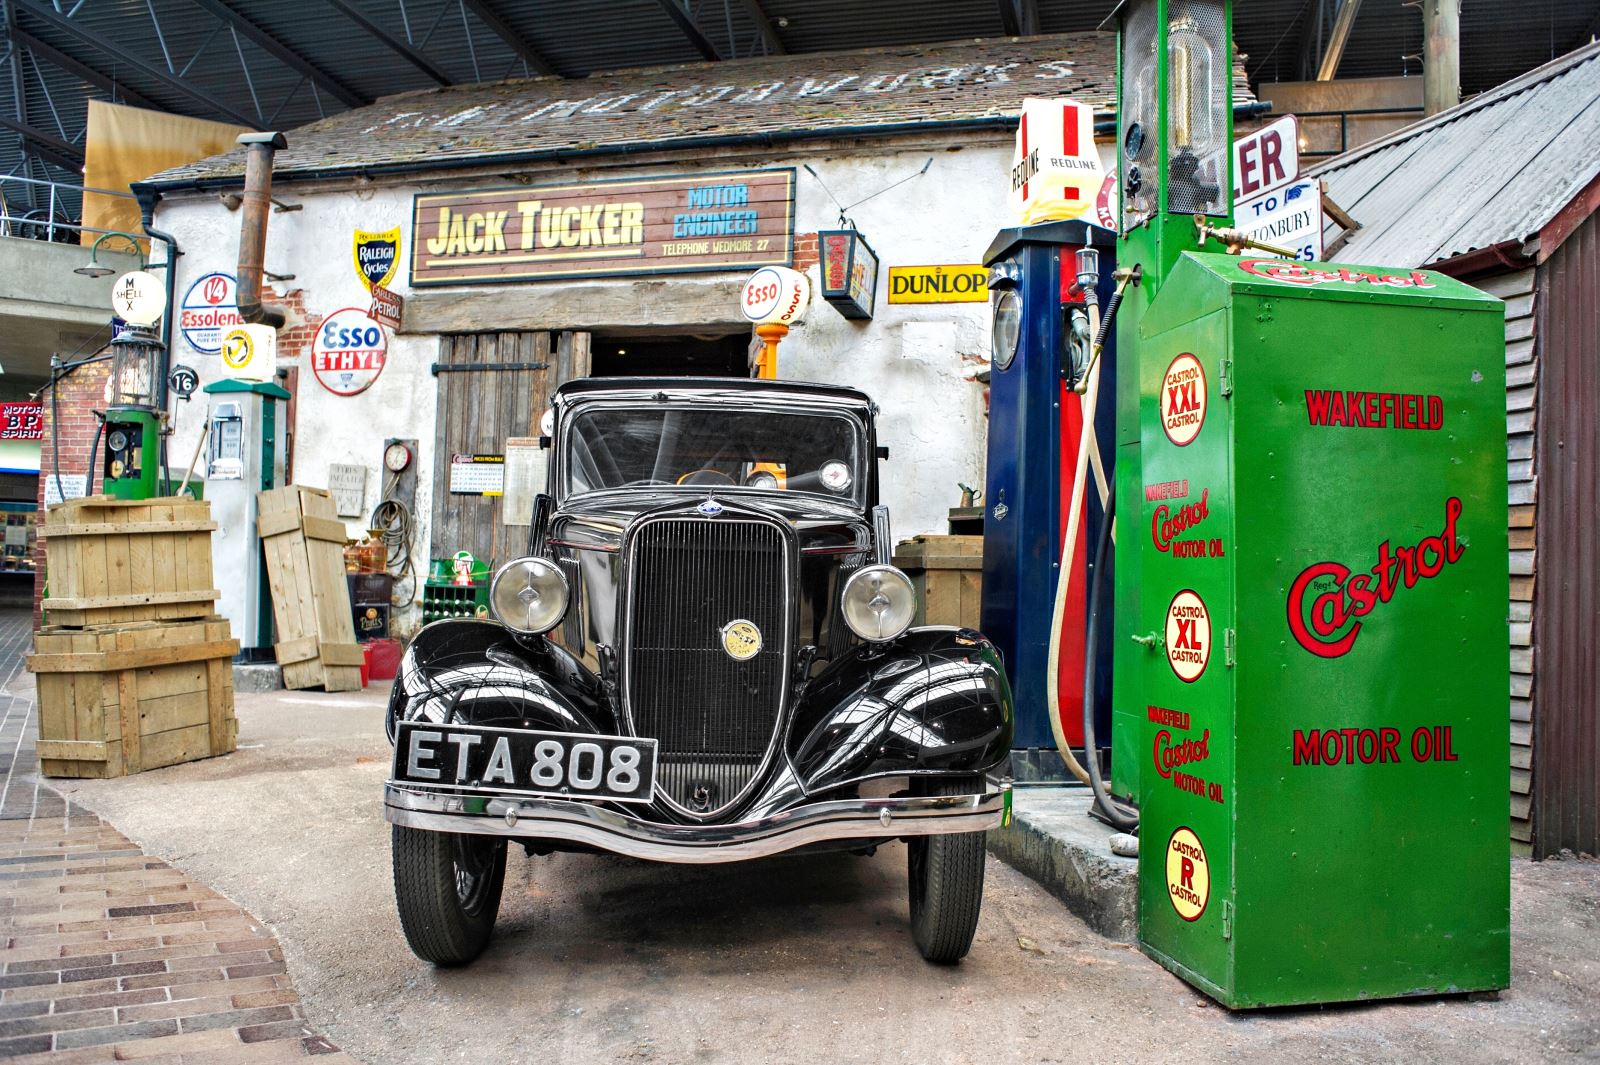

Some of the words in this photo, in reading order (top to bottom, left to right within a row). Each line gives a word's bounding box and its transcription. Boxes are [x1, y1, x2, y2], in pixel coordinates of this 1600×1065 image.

[1012, 147, 1039, 193] REDLINE
[1050, 158, 1097, 171] REDLINE
[1233, 128, 1286, 198] ER
[688, 183, 749, 210] MOTOR
[1252, 196, 1278, 217] TO
[427, 206, 508, 256] JACK
[518, 200, 645, 251] TUCKER
[673, 210, 758, 239] ENGINEER
[1251, 207, 1314, 242] TONBURY
[359, 245, 395, 263] RALEIGH
[662, 242, 709, 256] TELEPHONE
[713, 240, 753, 254] WEDMORE
[757, 239, 769, 251] 27
[363, 262, 389, 278] Cycles
[1238, 258, 1436, 289] Castrol
[116, 289, 144, 300] SHELL
[747, 283, 778, 306] ESSO
[892, 273, 987, 295] DUNLOP
[182, 310, 243, 328] Essolene
[371, 297, 401, 319] PETROL
[314, 351, 382, 370] ETHYL
[1166, 366, 1200, 386] CASTROL
[1167, 379, 1201, 417] XXL
[3, 405, 44, 415] MOTOR
[1166, 411, 1200, 430] CASTROL
[1304, 389, 1444, 431] WAKEFIELD
[1, 429, 43, 439] SPIRIT
[1144, 479, 1188, 502] WAKEFIELD
[1152, 487, 1209, 553] Castrol
[1172, 540, 1206, 558] MOTOR
[1209, 538, 1225, 557] OIL
[1286, 496, 1466, 660] Castrol
[1171, 605, 1205, 619] CASTROL
[1174, 618, 1202, 651] XL
[1171, 649, 1203, 664] CASTROL
[1147, 704, 1190, 731] WAKEFIELD
[1153, 728, 1210, 779] Castrol
[1292, 727, 1401, 766] MOTOR
[1410, 725, 1459, 763] OIL
[407, 730, 515, 784] ETA
[530, 740, 641, 794] 808
[1173, 770, 1206, 797] MOTOR
[1208, 782, 1225, 804] OIL
[1172, 839, 1204, 862] CASTROL
[1181, 855, 1195, 891] R
[1170, 883, 1202, 908] CASTROL
